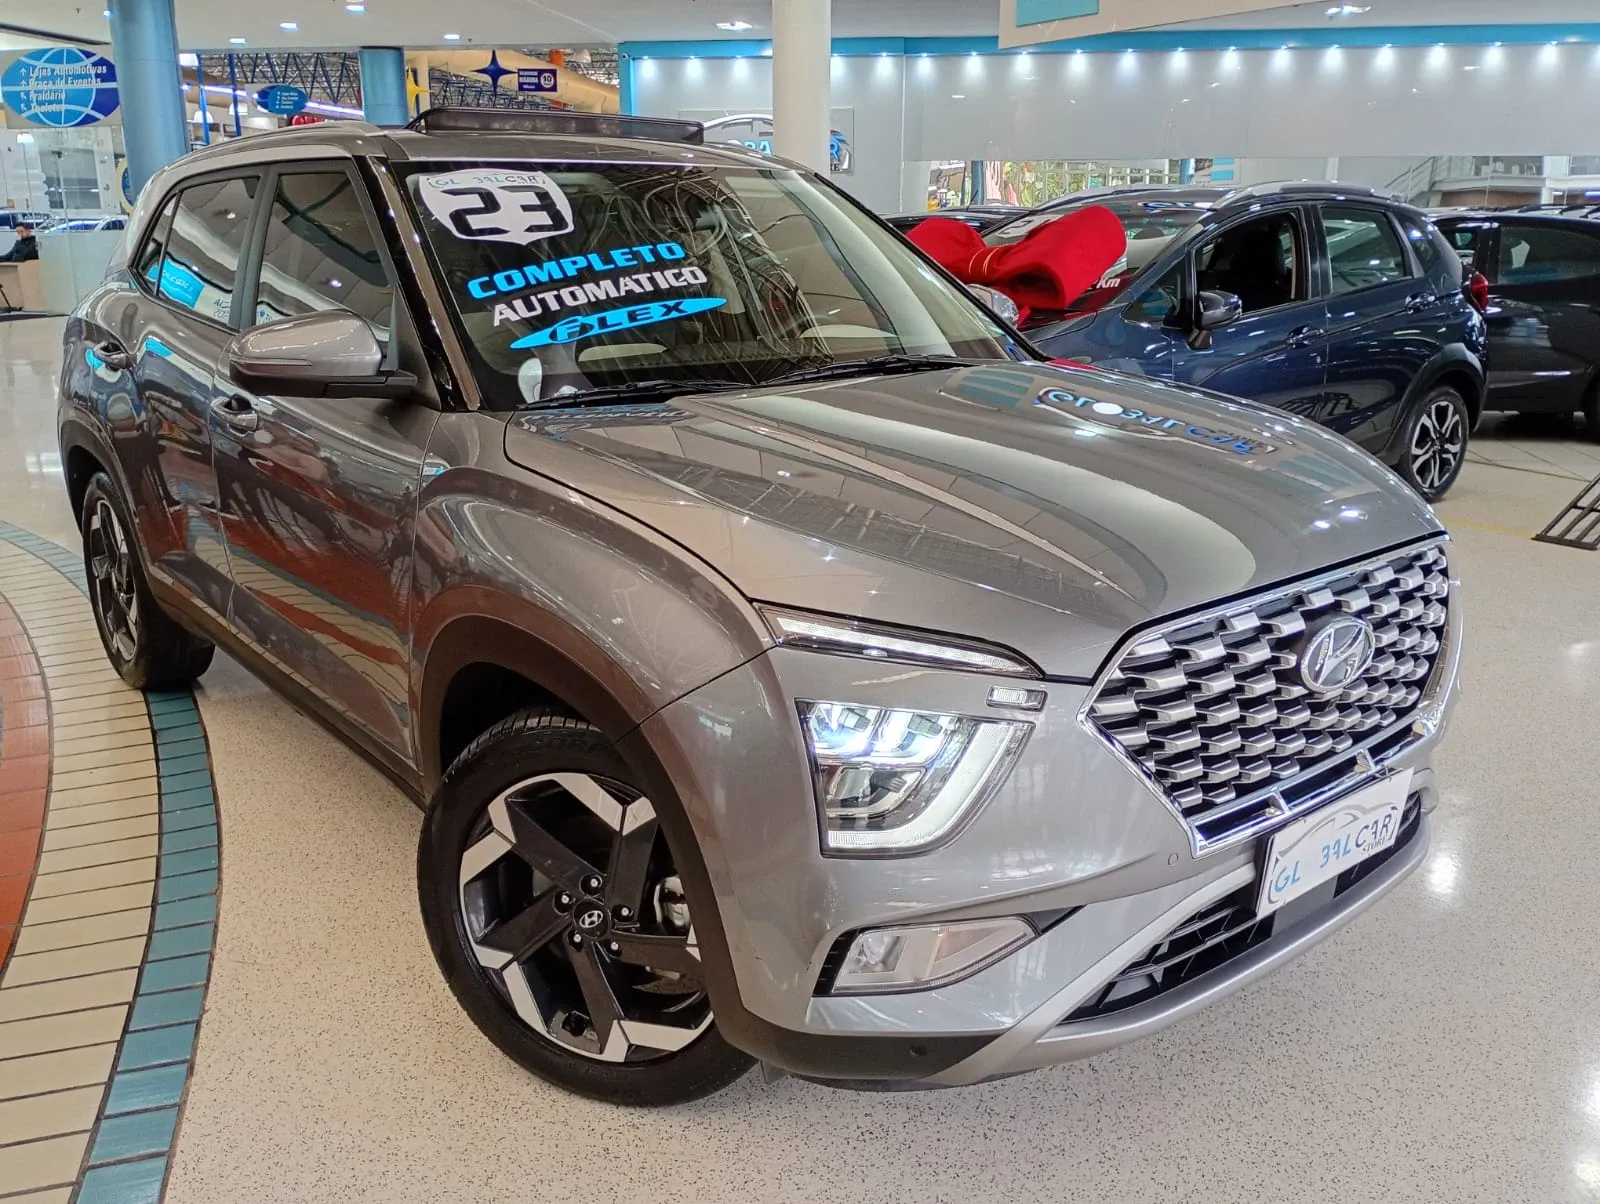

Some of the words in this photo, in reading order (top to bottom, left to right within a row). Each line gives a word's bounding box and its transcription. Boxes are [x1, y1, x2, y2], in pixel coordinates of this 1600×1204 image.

[440, 186, 569, 238] 23
[467, 242, 687, 299] COMPLETO
[548, 300, 688, 344] FLEX
